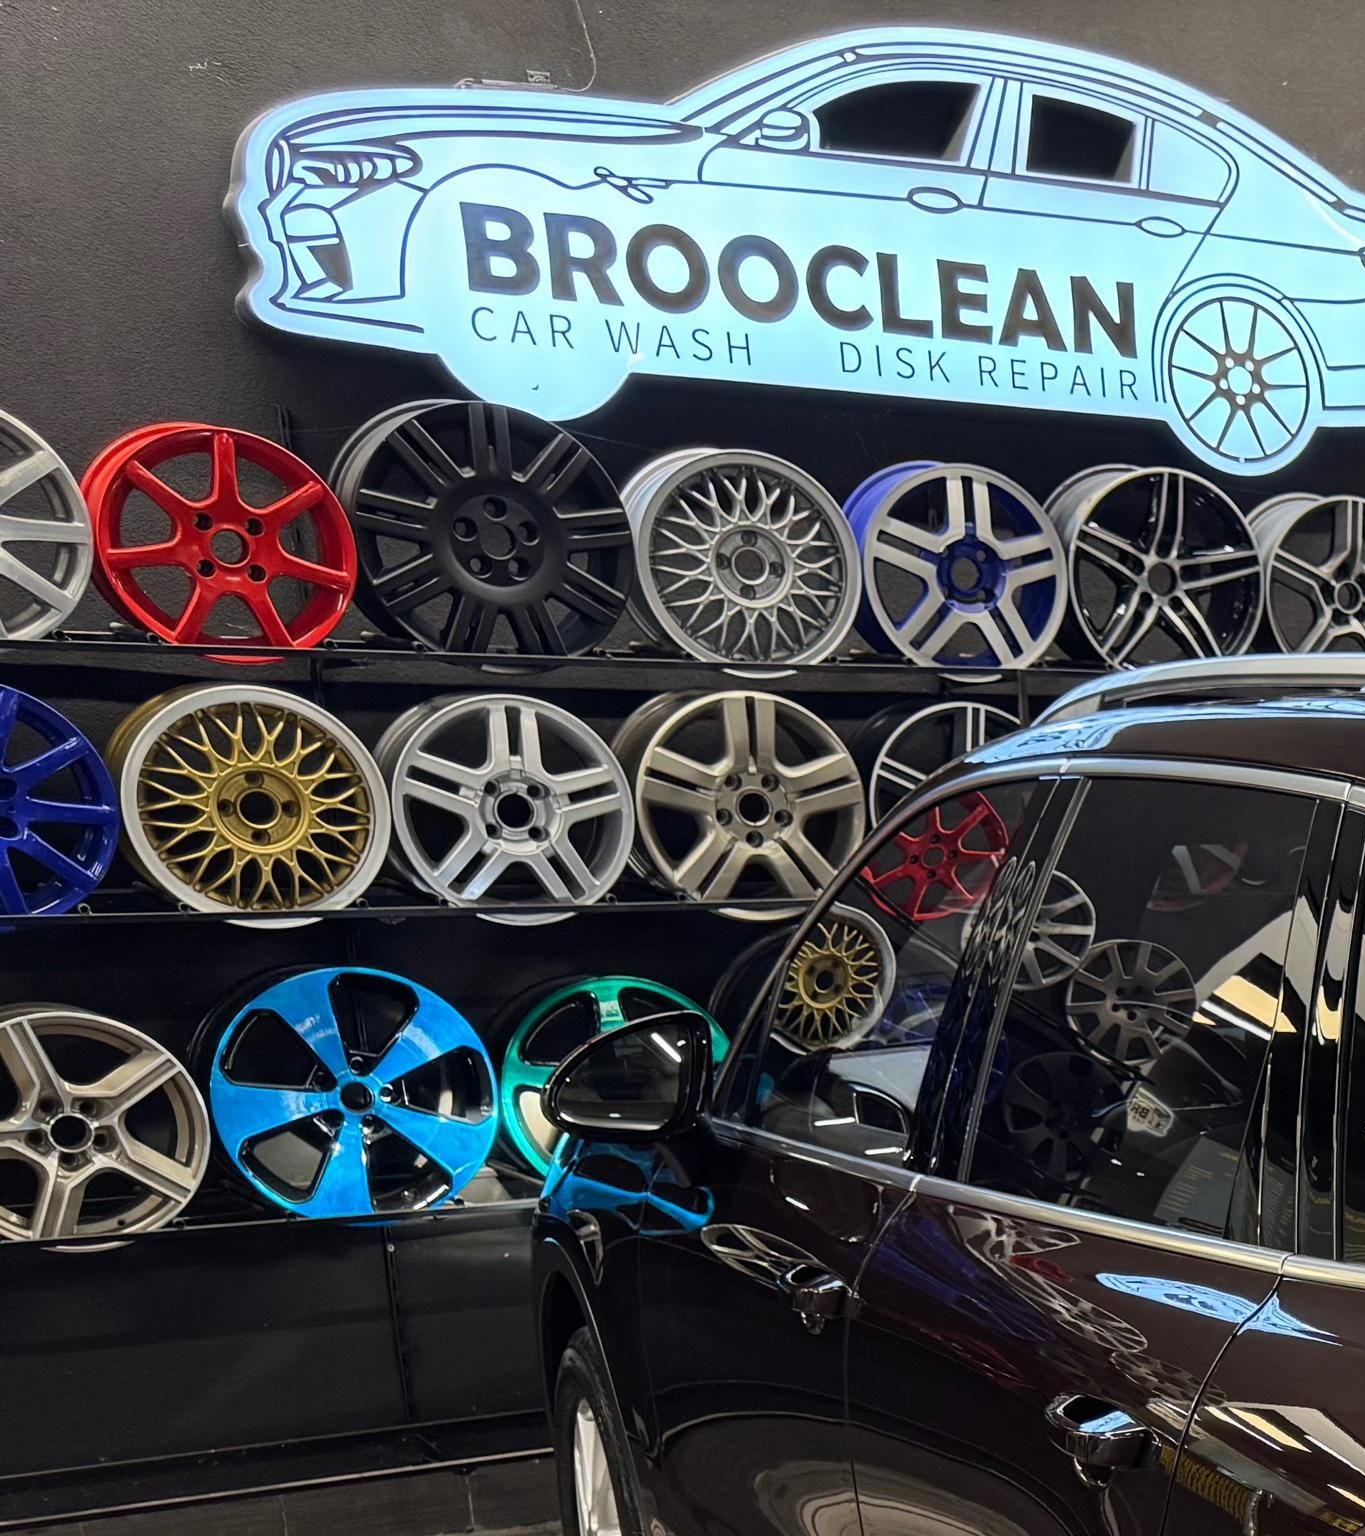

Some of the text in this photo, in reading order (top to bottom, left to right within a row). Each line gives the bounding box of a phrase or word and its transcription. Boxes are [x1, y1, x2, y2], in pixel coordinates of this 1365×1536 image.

[459, 201, 1138, 359] BROOCLEAN
[471, 307, 1139, 400] CAR WASH DISK REPAIR
